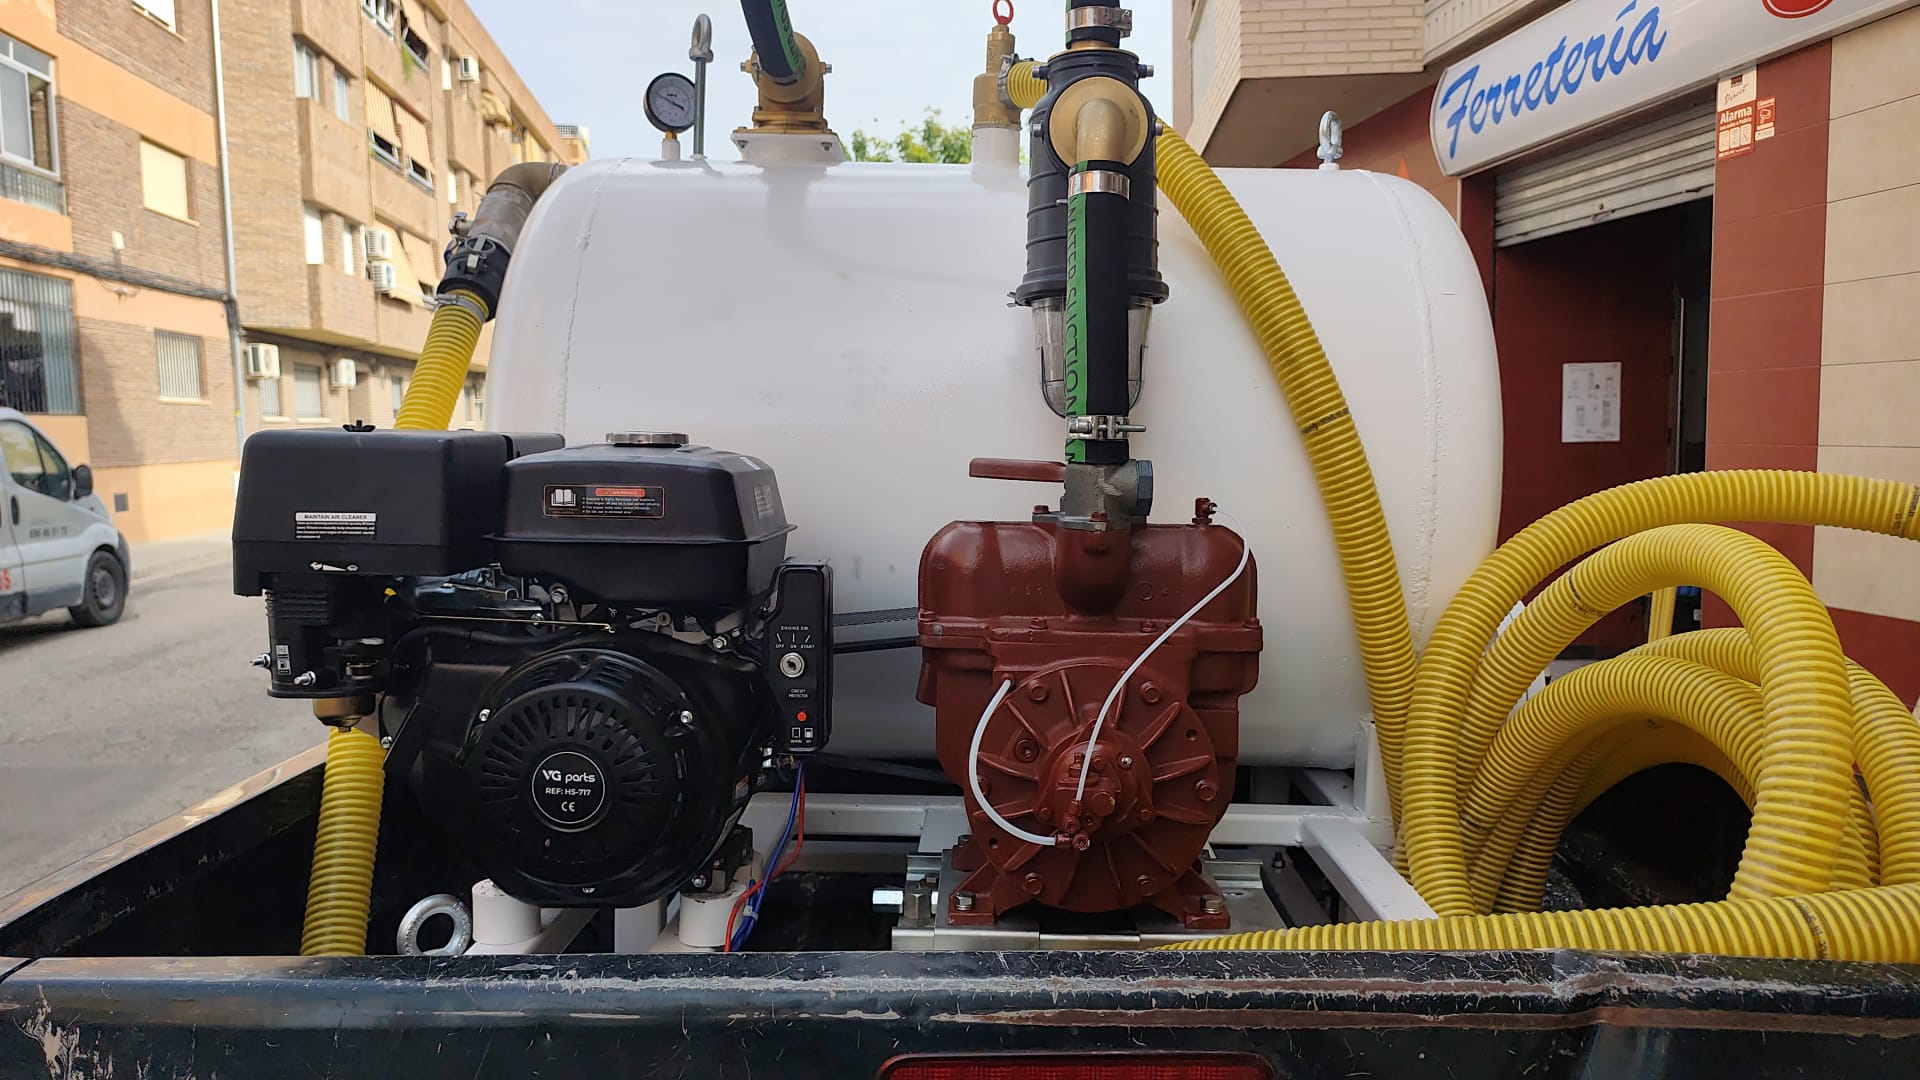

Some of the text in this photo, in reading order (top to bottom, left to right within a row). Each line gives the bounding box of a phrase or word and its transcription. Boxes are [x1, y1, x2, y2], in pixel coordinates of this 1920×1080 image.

[1440, 0, 1667, 159] Ferretería
[1720, 106, 1752, 125] Alarma
[542, 769, 596, 784] VG parts
[545, 787, 591, 796] REF: HS-717
[561, 801, 576, 812] CE
